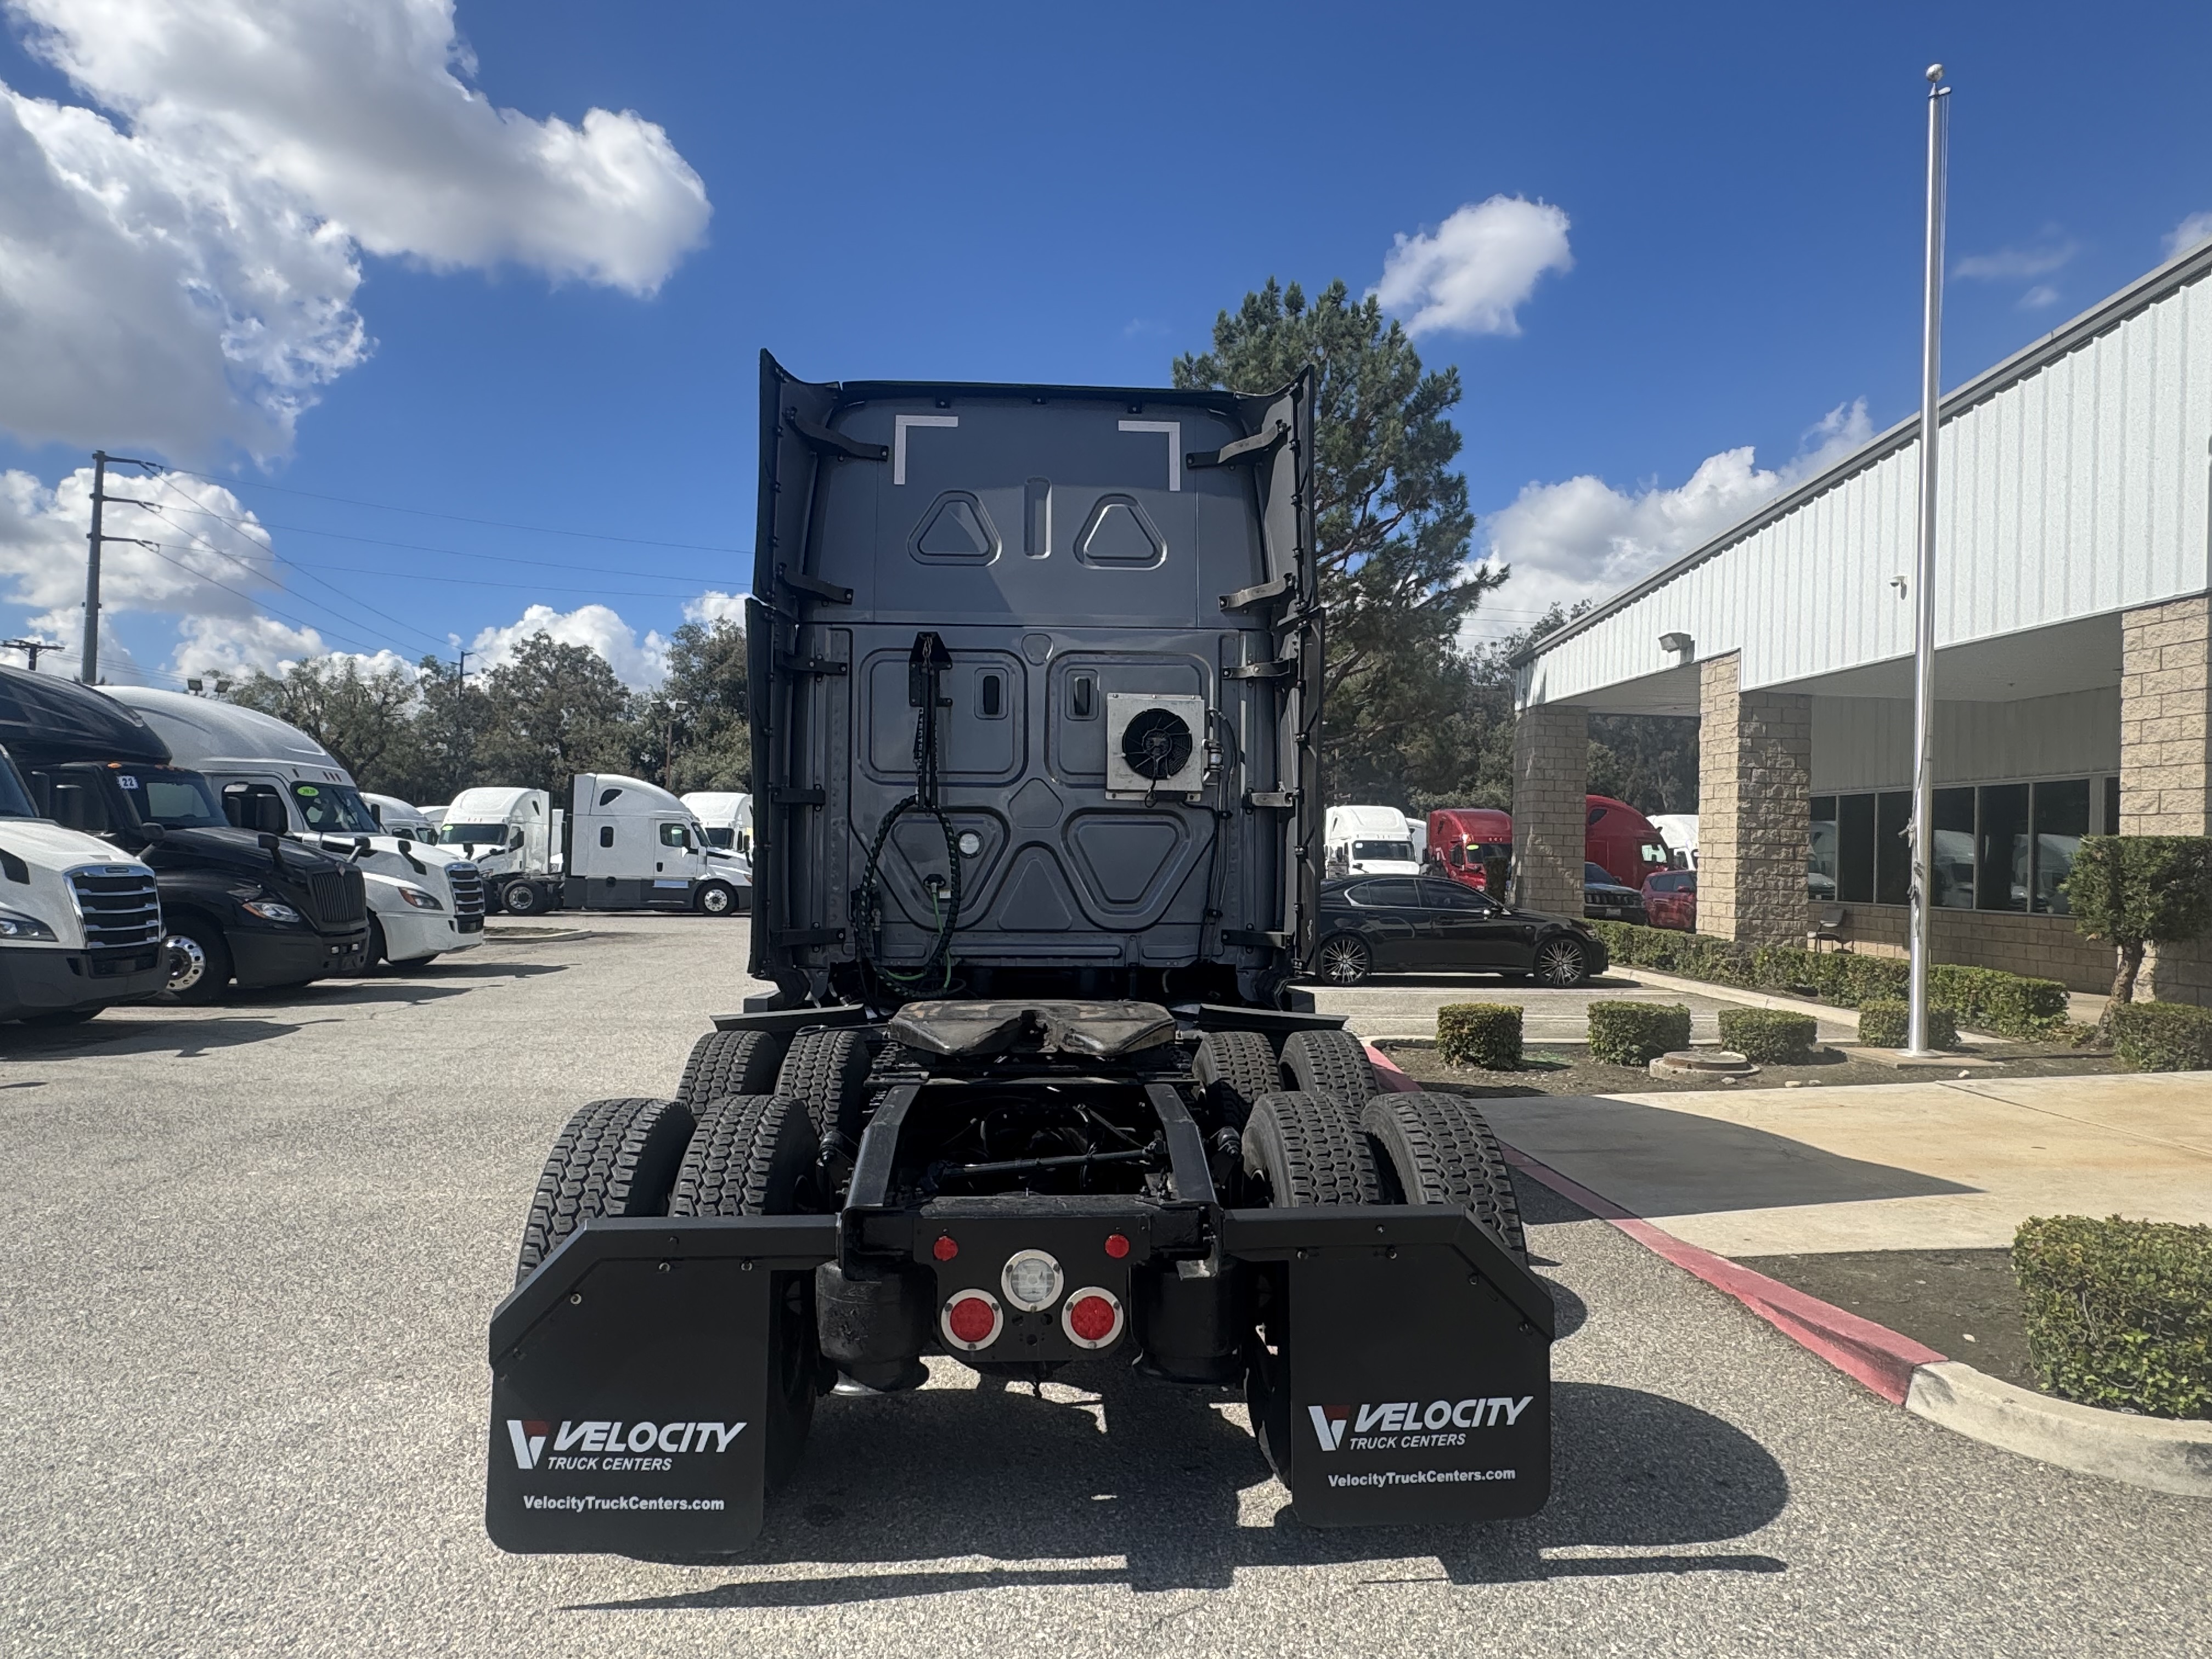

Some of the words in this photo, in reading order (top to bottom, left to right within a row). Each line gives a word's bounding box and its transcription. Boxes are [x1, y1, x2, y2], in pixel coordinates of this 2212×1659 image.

[122, 777, 134, 787] 22
[1354, 1396, 1534, 1432] VELOCITY
[553, 1421, 747, 1453] VELOCITY
[1350, 1436, 1397, 1450] TRUCK
[1401, 1433, 1466, 1448] CENTERS
[548, 1457, 599, 1470] TRUCK
[602, 1457, 673, 1471] CENTERS
[1328, 1468, 1516, 1488] VelocityTruckCenters.com
[523, 1496, 725, 1513] VelocityTruckCenters.com
